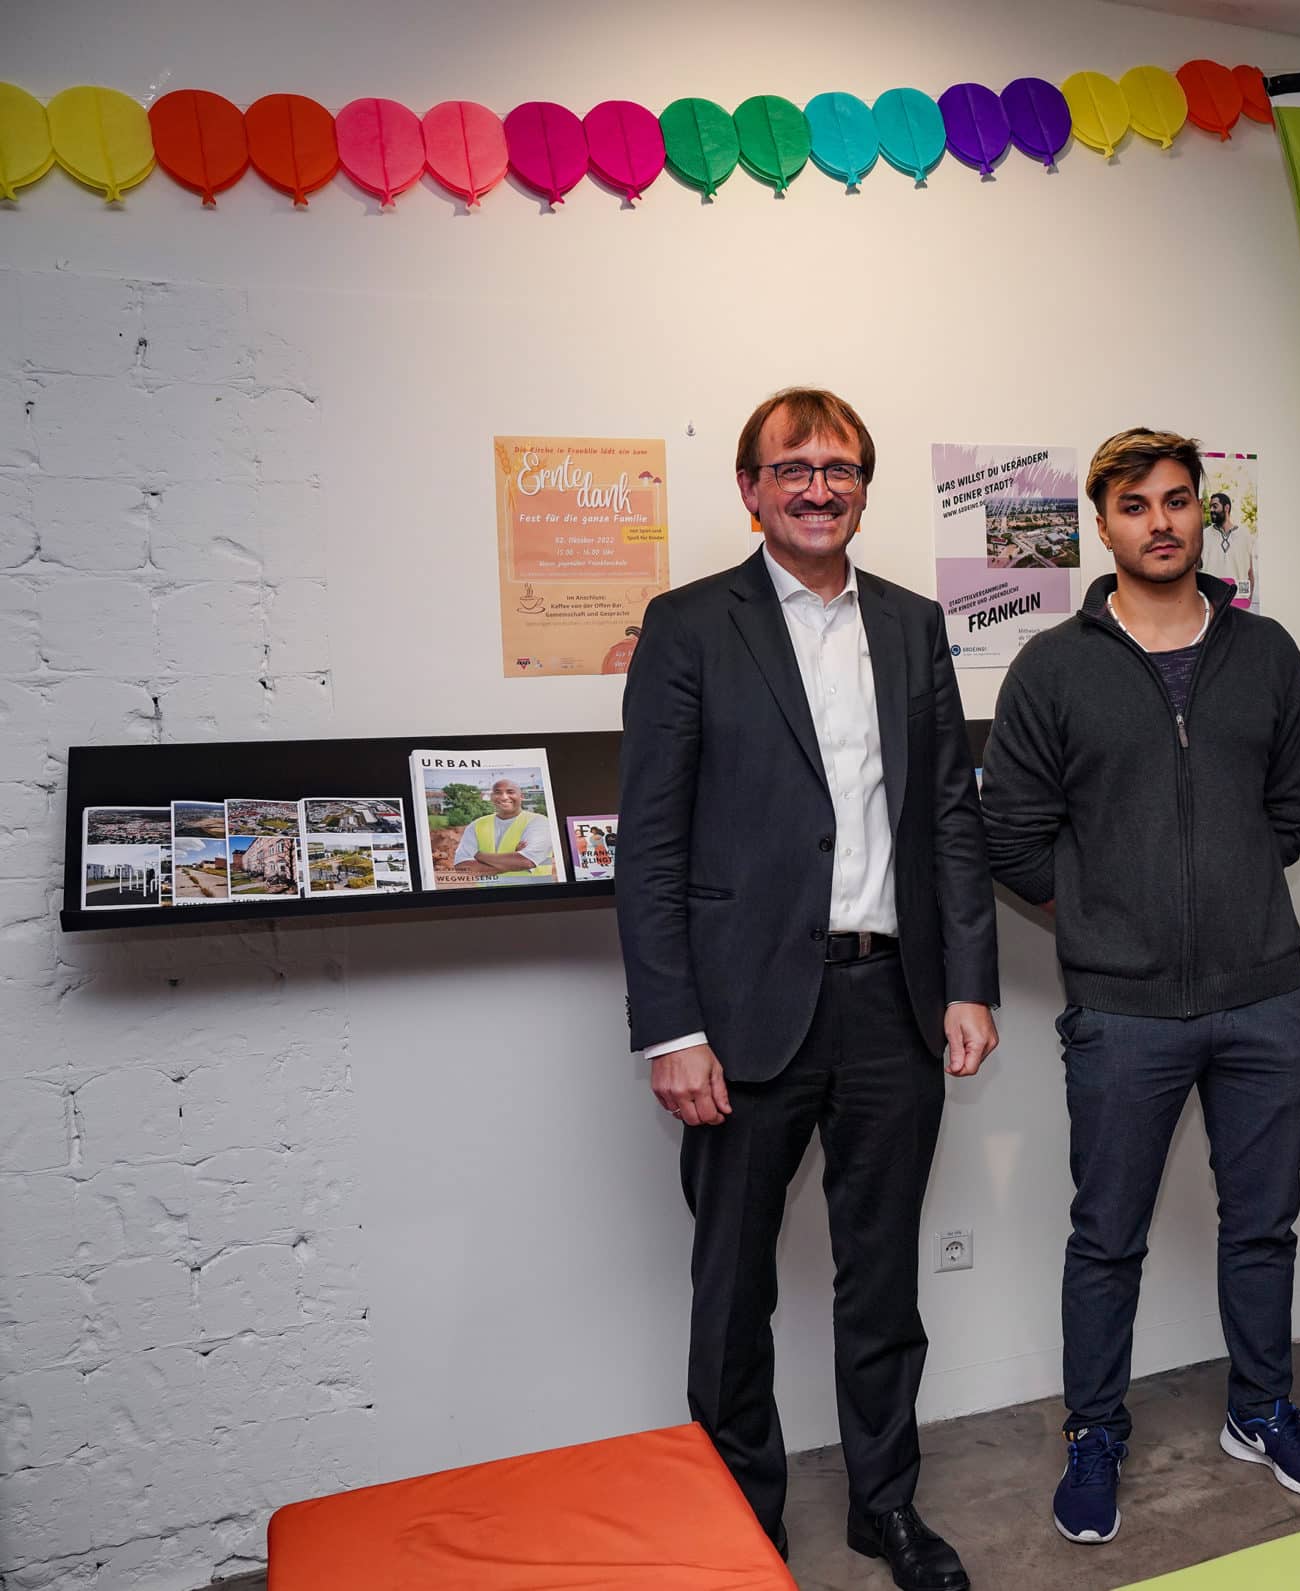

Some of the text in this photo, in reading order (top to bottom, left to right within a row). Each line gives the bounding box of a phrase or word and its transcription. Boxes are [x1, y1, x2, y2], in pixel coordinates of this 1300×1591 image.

[516, 452, 582, 496] Ernte
[936, 450, 1049, 494] WAS WILLST DU VERÄNDERN
[576, 471, 633, 514] dank
[942, 477, 1015, 509] IN DEINER STADT?
[519, 513, 541, 523] Fest
[545, 513, 560, 523] für
[563, 513, 578, 523] die
[613, 513, 648, 523] Familie
[967, 591, 1041, 633] FRANKLIN
[421, 758, 482, 768] URBAN
[437, 874, 499, 882] WEGWEISEND
